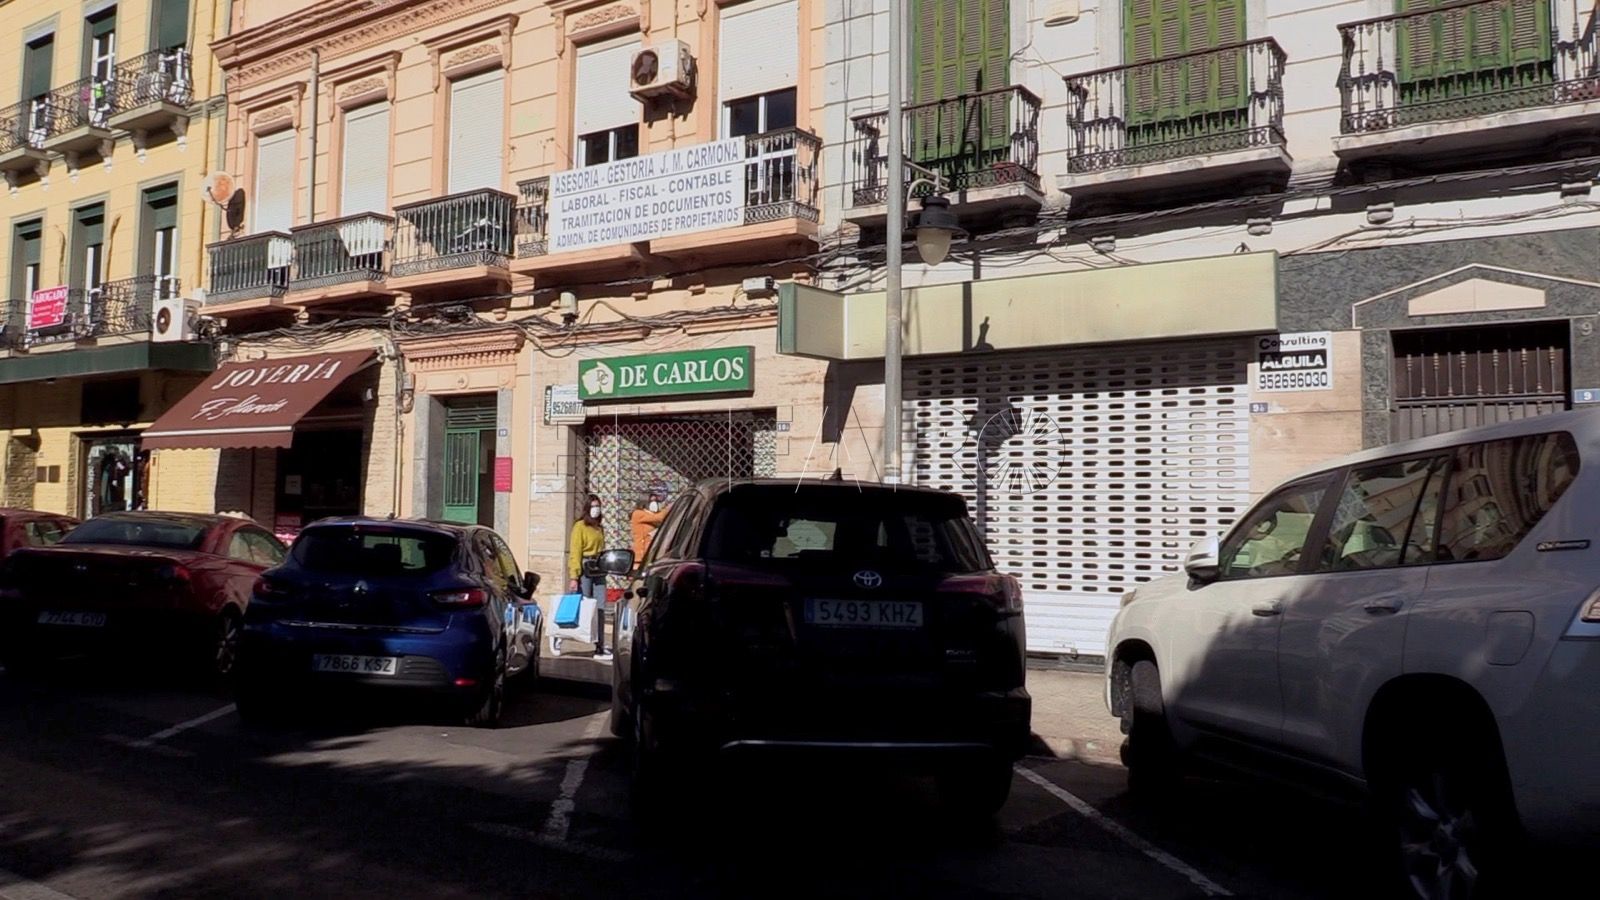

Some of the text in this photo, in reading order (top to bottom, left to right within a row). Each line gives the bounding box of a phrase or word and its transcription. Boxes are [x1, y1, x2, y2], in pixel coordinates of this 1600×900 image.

[607, 157, 654, 184] GESTORIA
[686, 141, 739, 169] CARMONA
[561, 193, 610, 213] LABORAL
[619, 184, 658, 202] FISCAL
[668, 170, 732, 194] CONTABLE
[561, 190, 732, 231] TRAMITACION DE DOCUMENTOS
[556, 207, 739, 248] ADMON. DE COMUNIDADES DE PROPIETARIOS
[1581, 321, 1593, 336] 9
[1259, 337, 1327, 350] Consulting
[618, 356, 745, 388] DE CARLOS
[1261, 354, 1325, 370] ALQUILA
[1259, 371, 1328, 390] 952696030
[1583, 391, 1593, 401] 9
[819, 601, 918, 624] 5493 KHZ
[322, 655, 393, 673] 7866 KSZ
